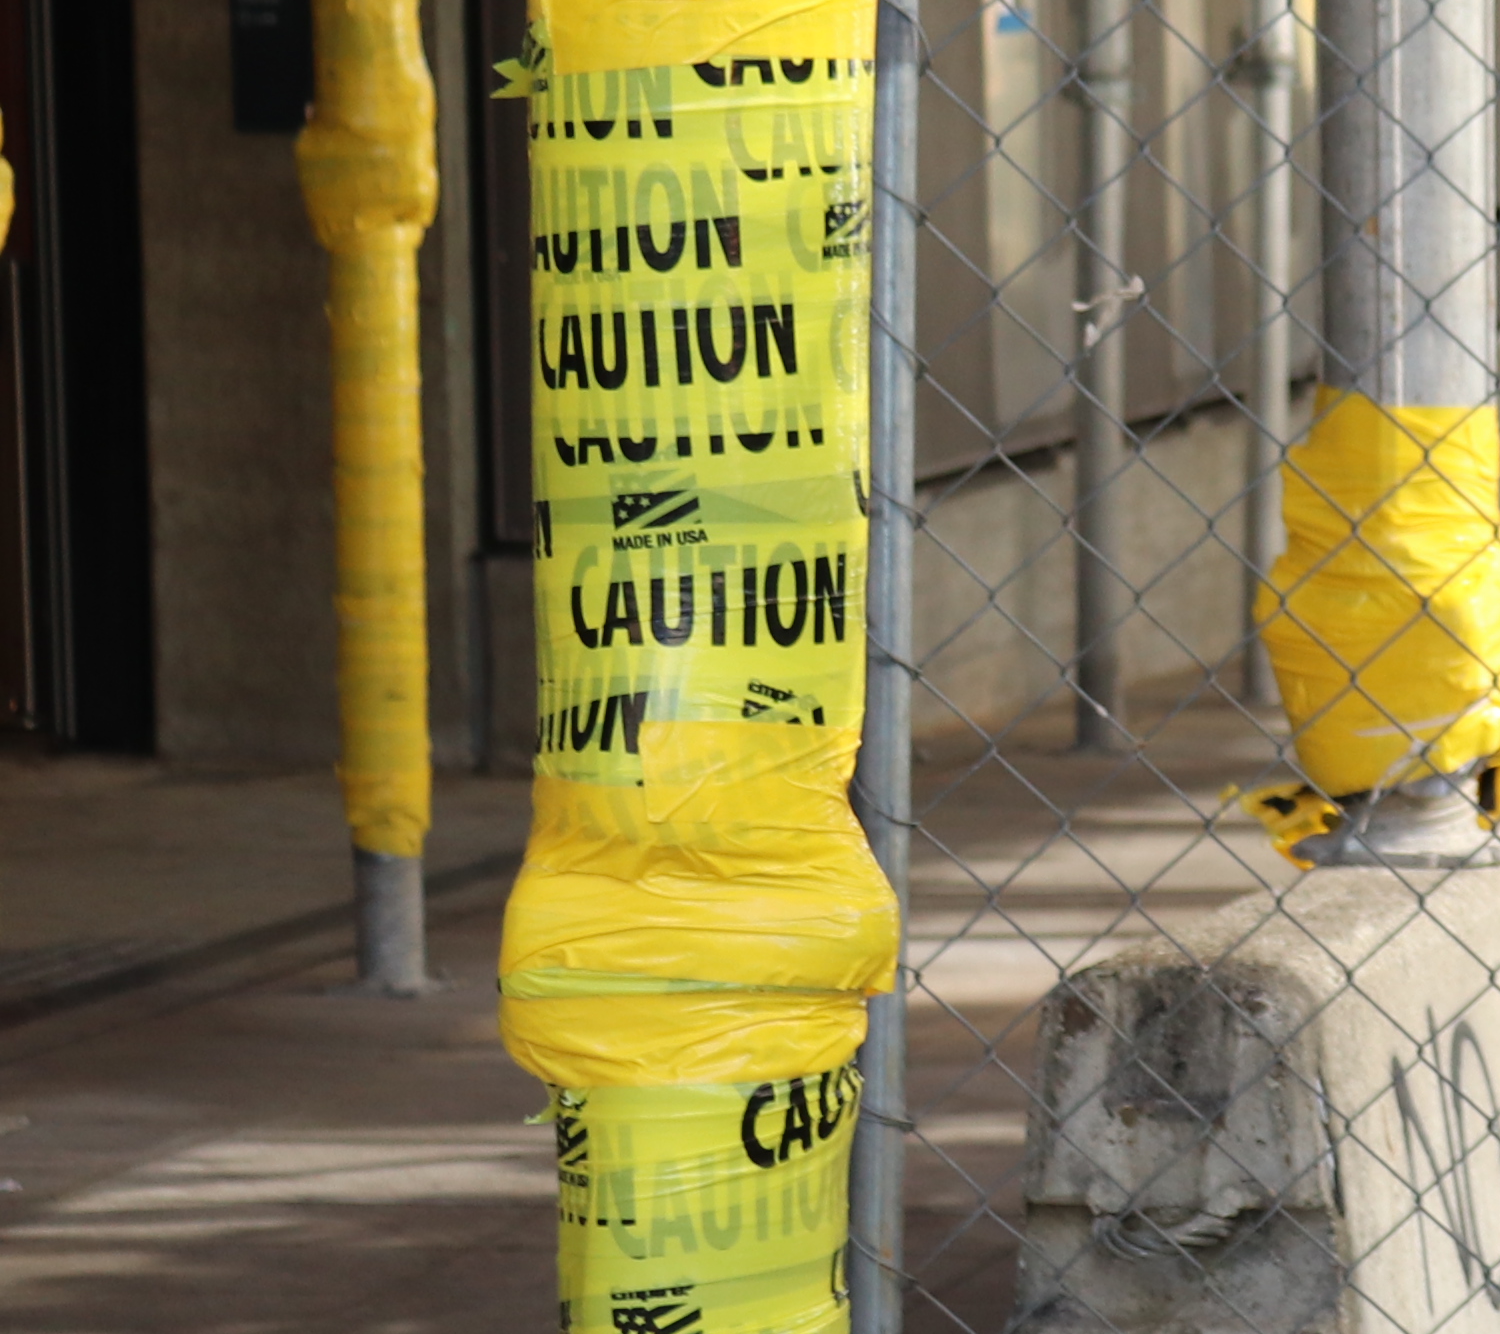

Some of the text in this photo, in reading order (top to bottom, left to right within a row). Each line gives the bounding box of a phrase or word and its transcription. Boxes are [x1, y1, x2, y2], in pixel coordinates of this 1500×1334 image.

[540, 275, 797, 390] CAUTION
[612, 528, 709, 551] MADE IN USA
[571, 543, 847, 649] CAUTION
